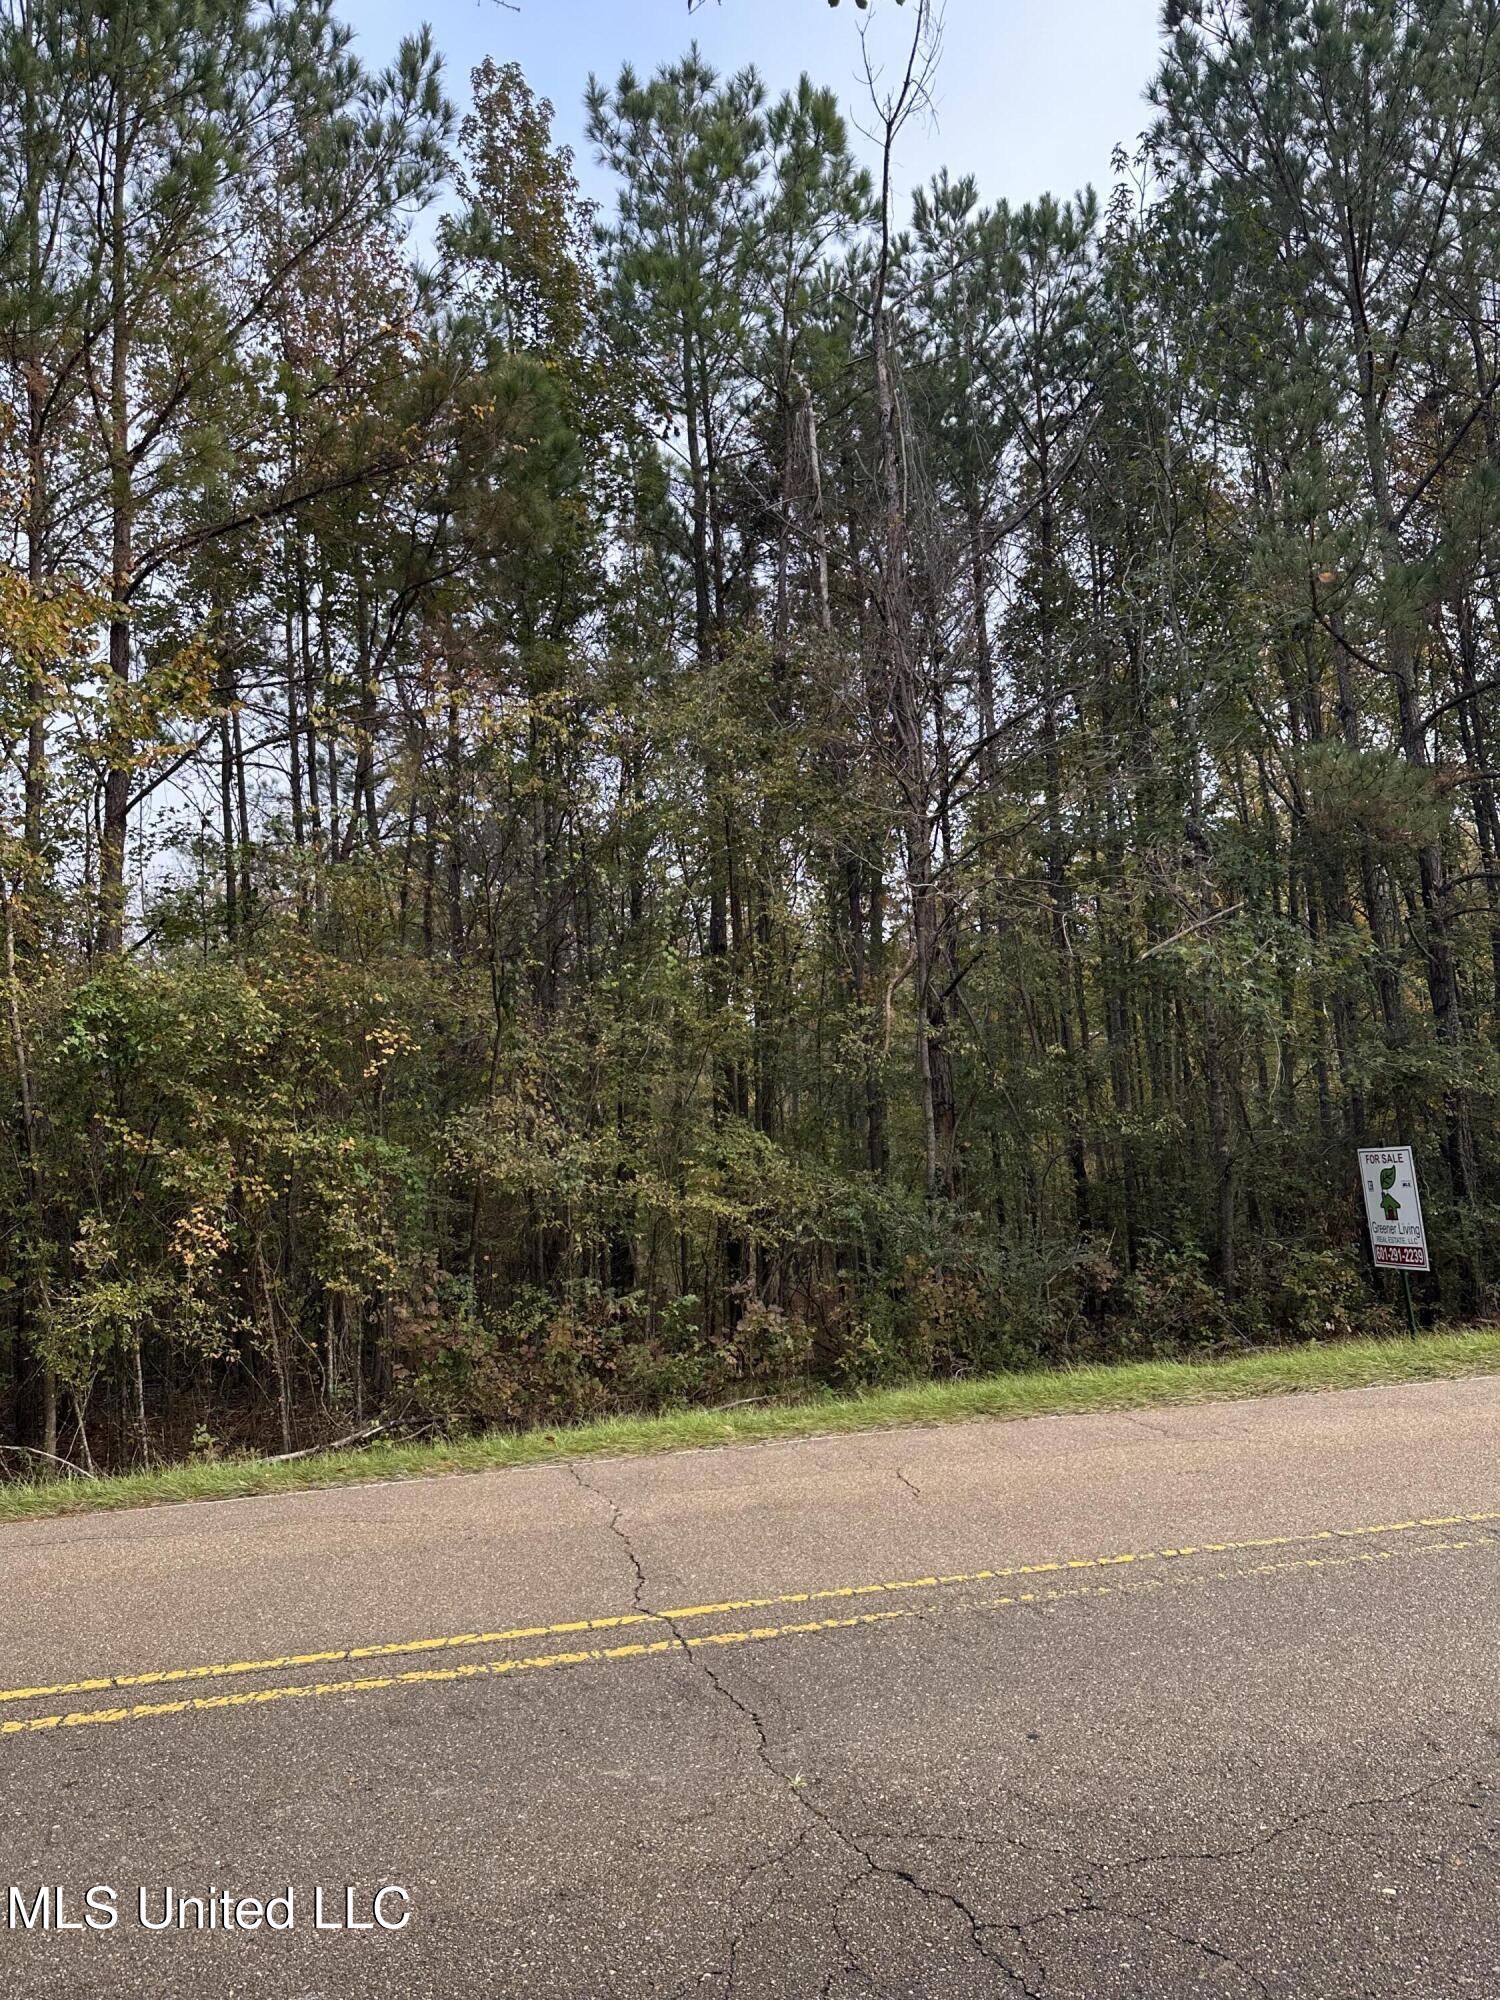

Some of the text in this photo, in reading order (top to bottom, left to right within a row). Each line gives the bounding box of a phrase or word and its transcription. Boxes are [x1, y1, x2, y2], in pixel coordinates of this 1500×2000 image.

[1365, 1153, 1404, 1164] FOR SALE
[1372, 1221, 1420, 1238] Greener Living
[1376, 1235, 1387, 1243] REAL
[1408, 1237, 1418, 1245] LLC
[1376, 1246, 1424, 1263] 601-291-2239
